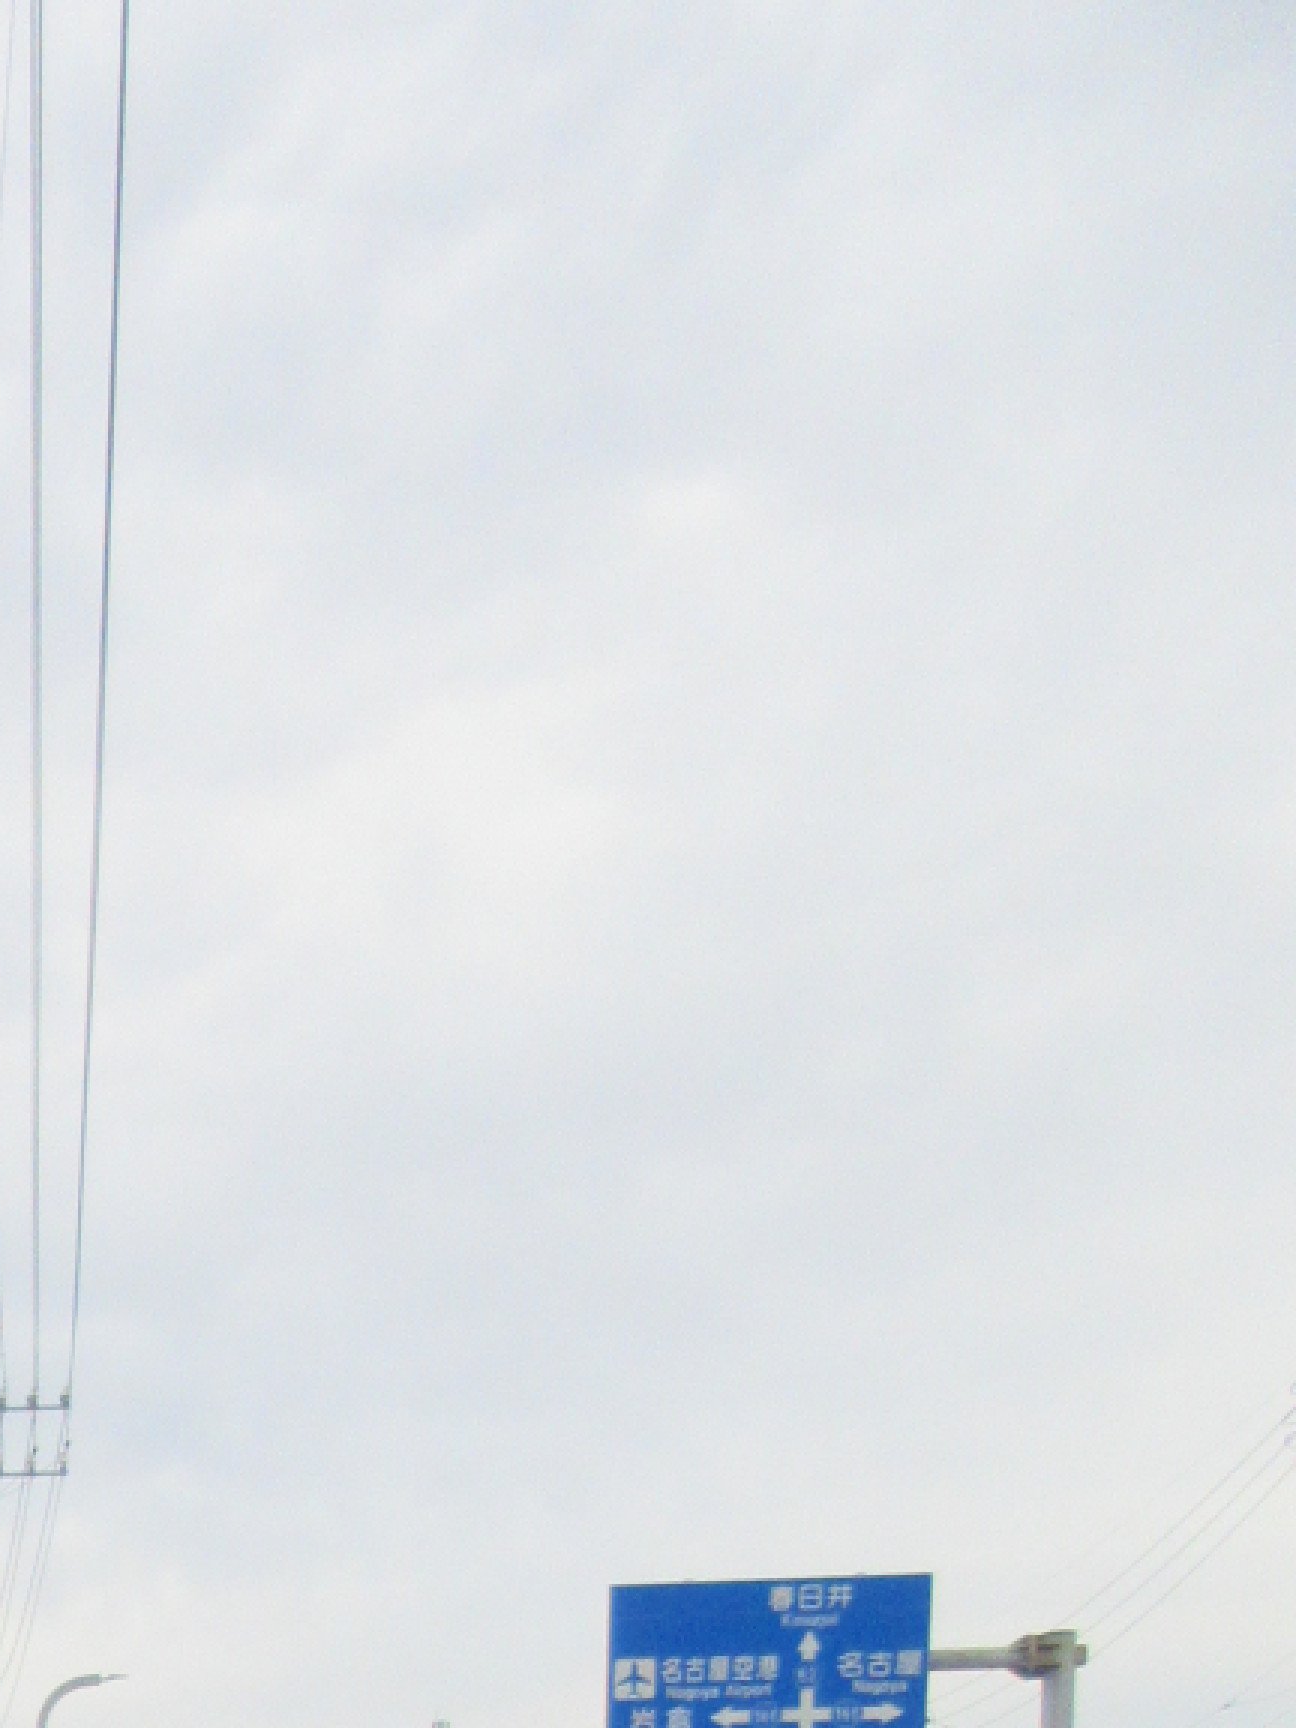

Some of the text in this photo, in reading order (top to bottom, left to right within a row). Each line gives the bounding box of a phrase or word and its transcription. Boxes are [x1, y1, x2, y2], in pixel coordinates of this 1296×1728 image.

[769, 1584, 852, 1611] 春日井
[662, 1655, 780, 1683] 名古屋空港
[838, 1650, 922, 1677] 名古屋
